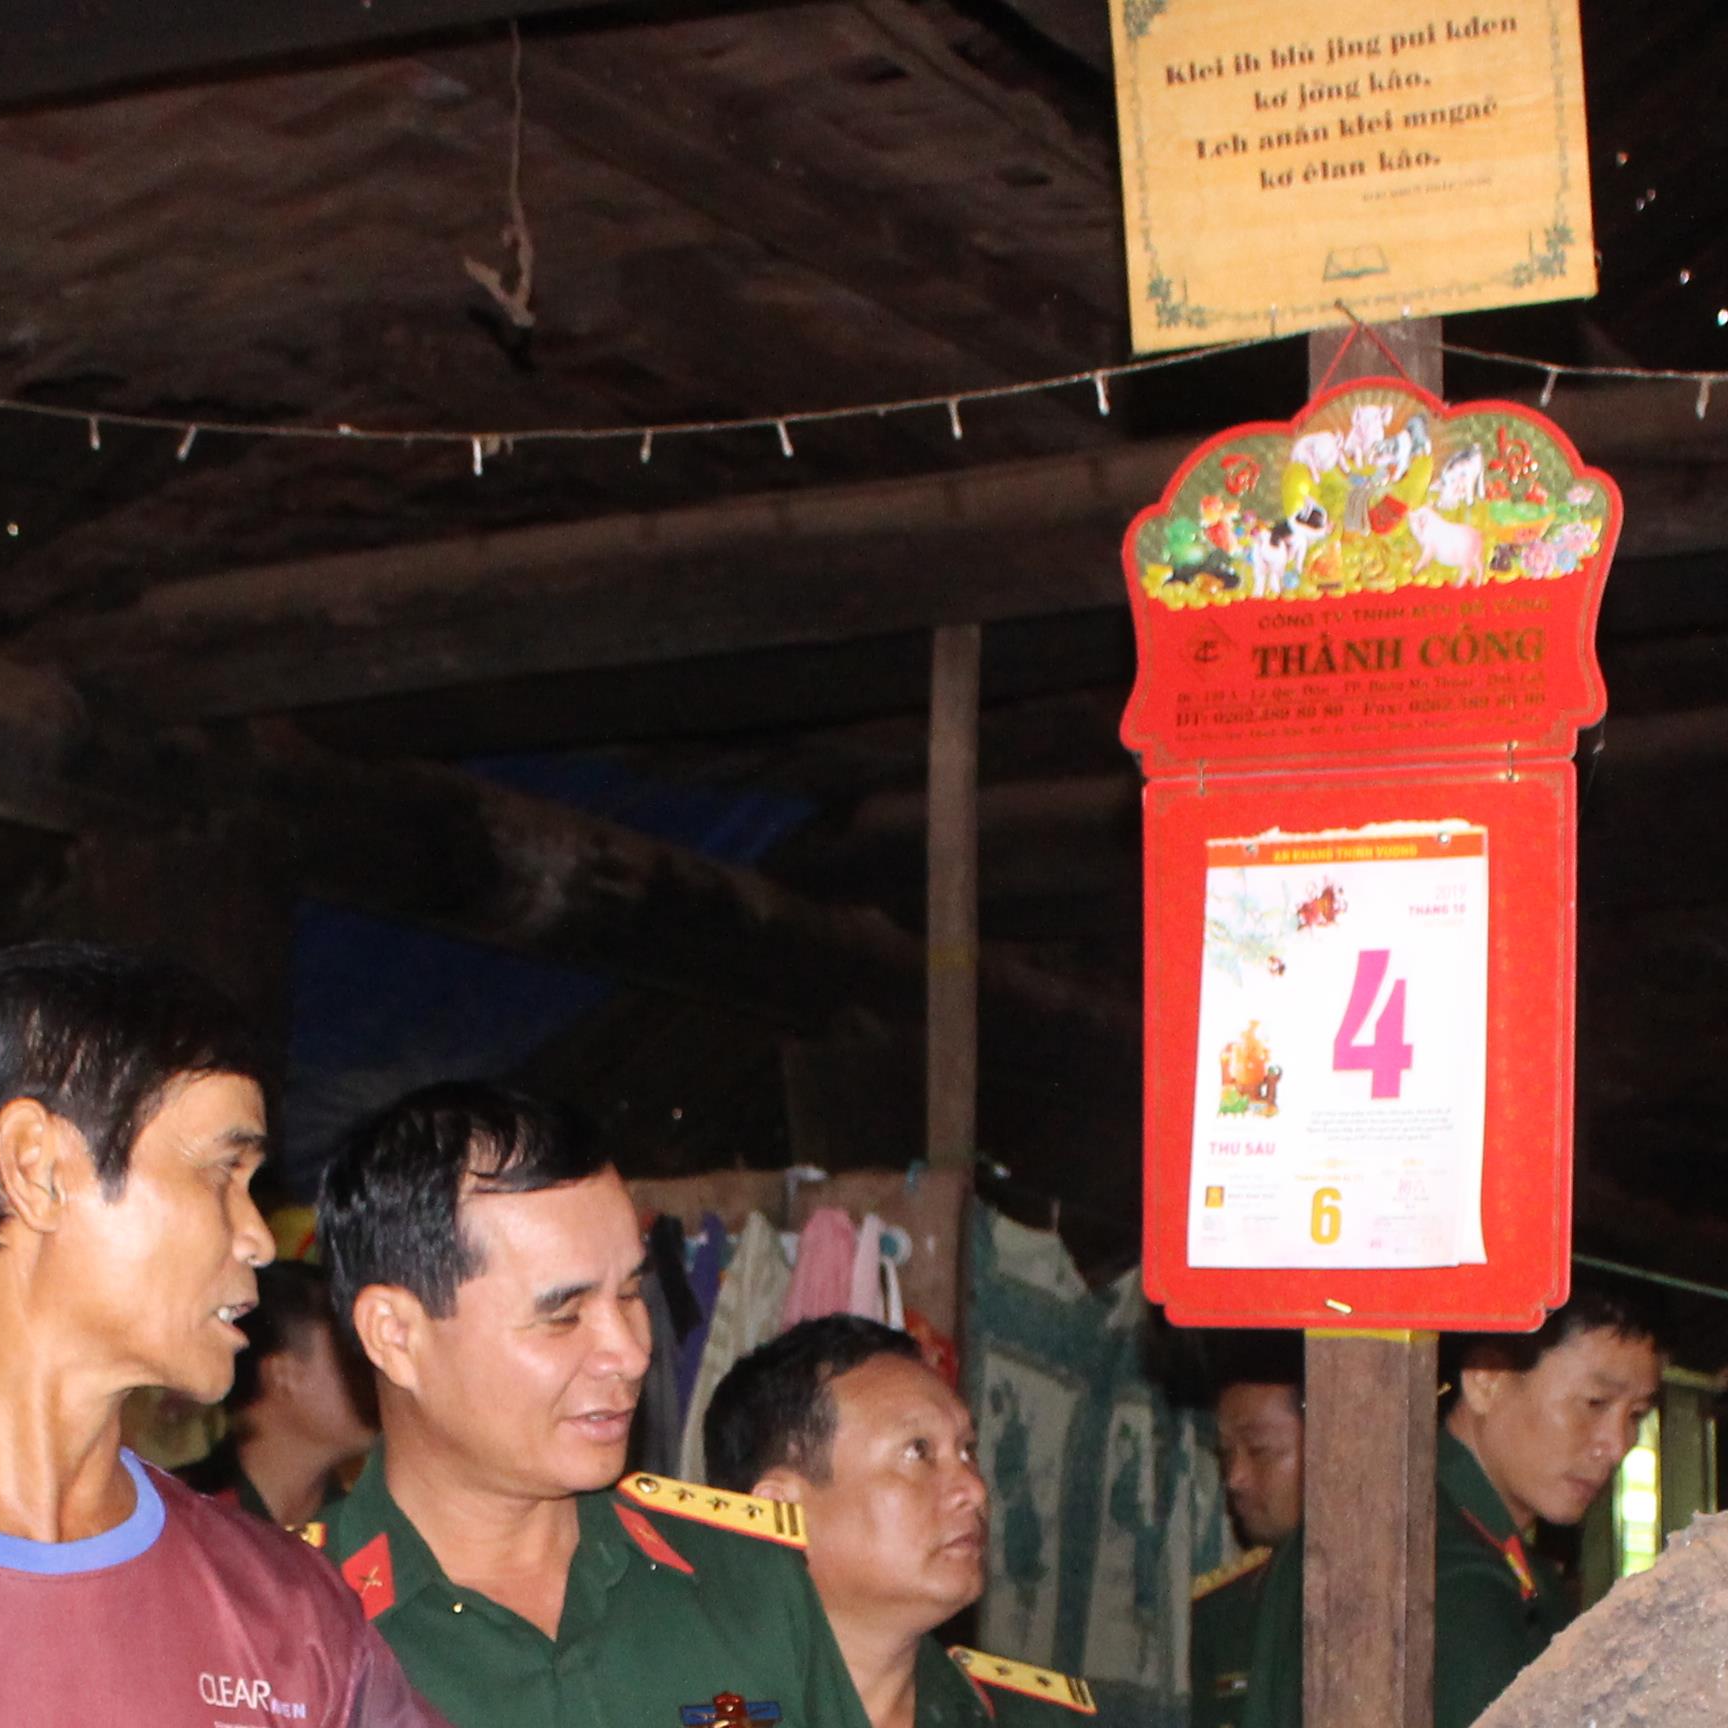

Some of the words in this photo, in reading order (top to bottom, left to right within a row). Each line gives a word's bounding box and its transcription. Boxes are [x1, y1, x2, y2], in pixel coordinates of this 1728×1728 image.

[1166, 56, 1224, 86] Klei
[1326, 34, 1382, 66] jing
[1390, 21, 1436, 56] pui
[1196, 131, 1249, 160] Leh
[1338, 108, 1394, 138] klei
[1253, 633, 1405, 679] THÀNH
[1419, 622, 1546, 668] CÔNG
[1332, 949, 1413, 1100] 4
[1309, 1187, 1343, 1245] 6
[199, 1672, 272, 1712] CLEAR
